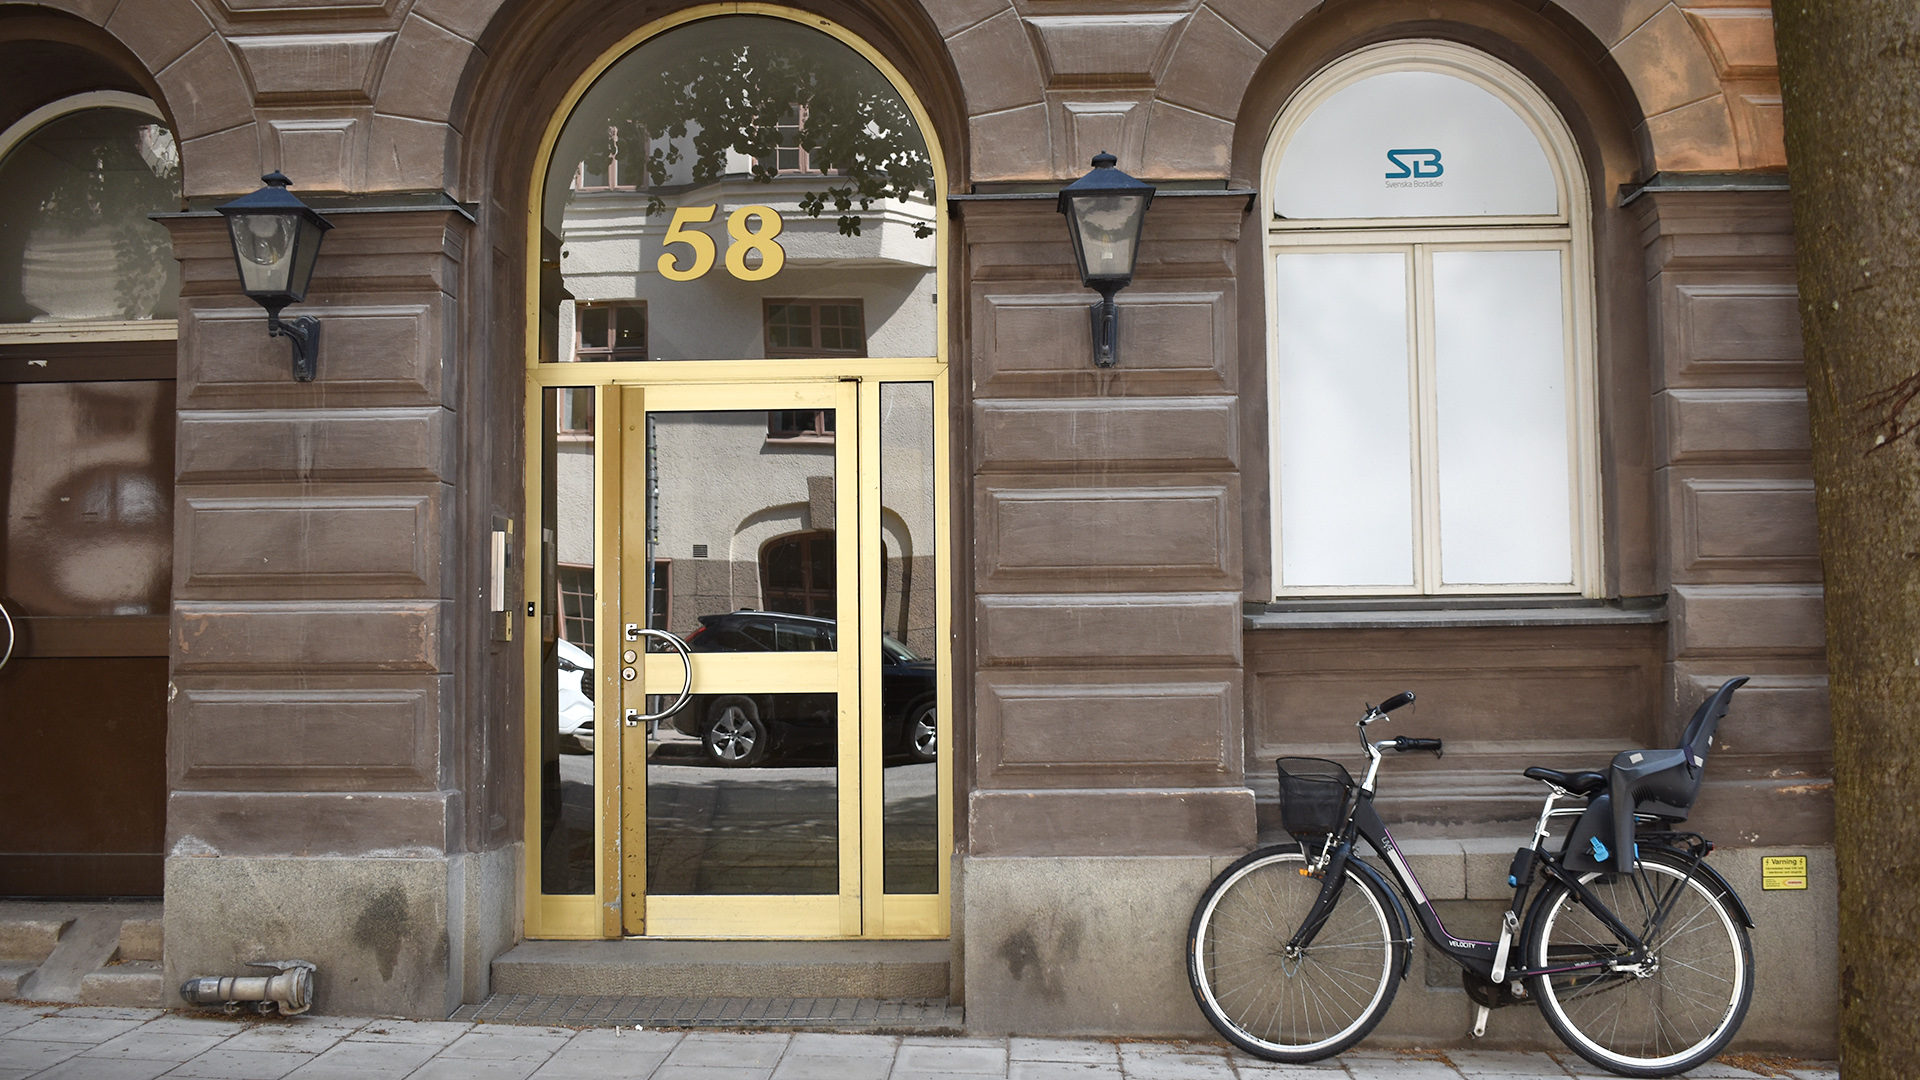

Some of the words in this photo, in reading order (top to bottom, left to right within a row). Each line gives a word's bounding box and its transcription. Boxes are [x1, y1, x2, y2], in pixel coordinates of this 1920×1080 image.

[1385, 148, 1444, 178] SB
[1385, 180, 1413, 188] Svenska
[657, 203, 786, 282] 58
[1771, 858, 1797, 866] Varning
[1448, 940, 1476, 949] VELOCITY
